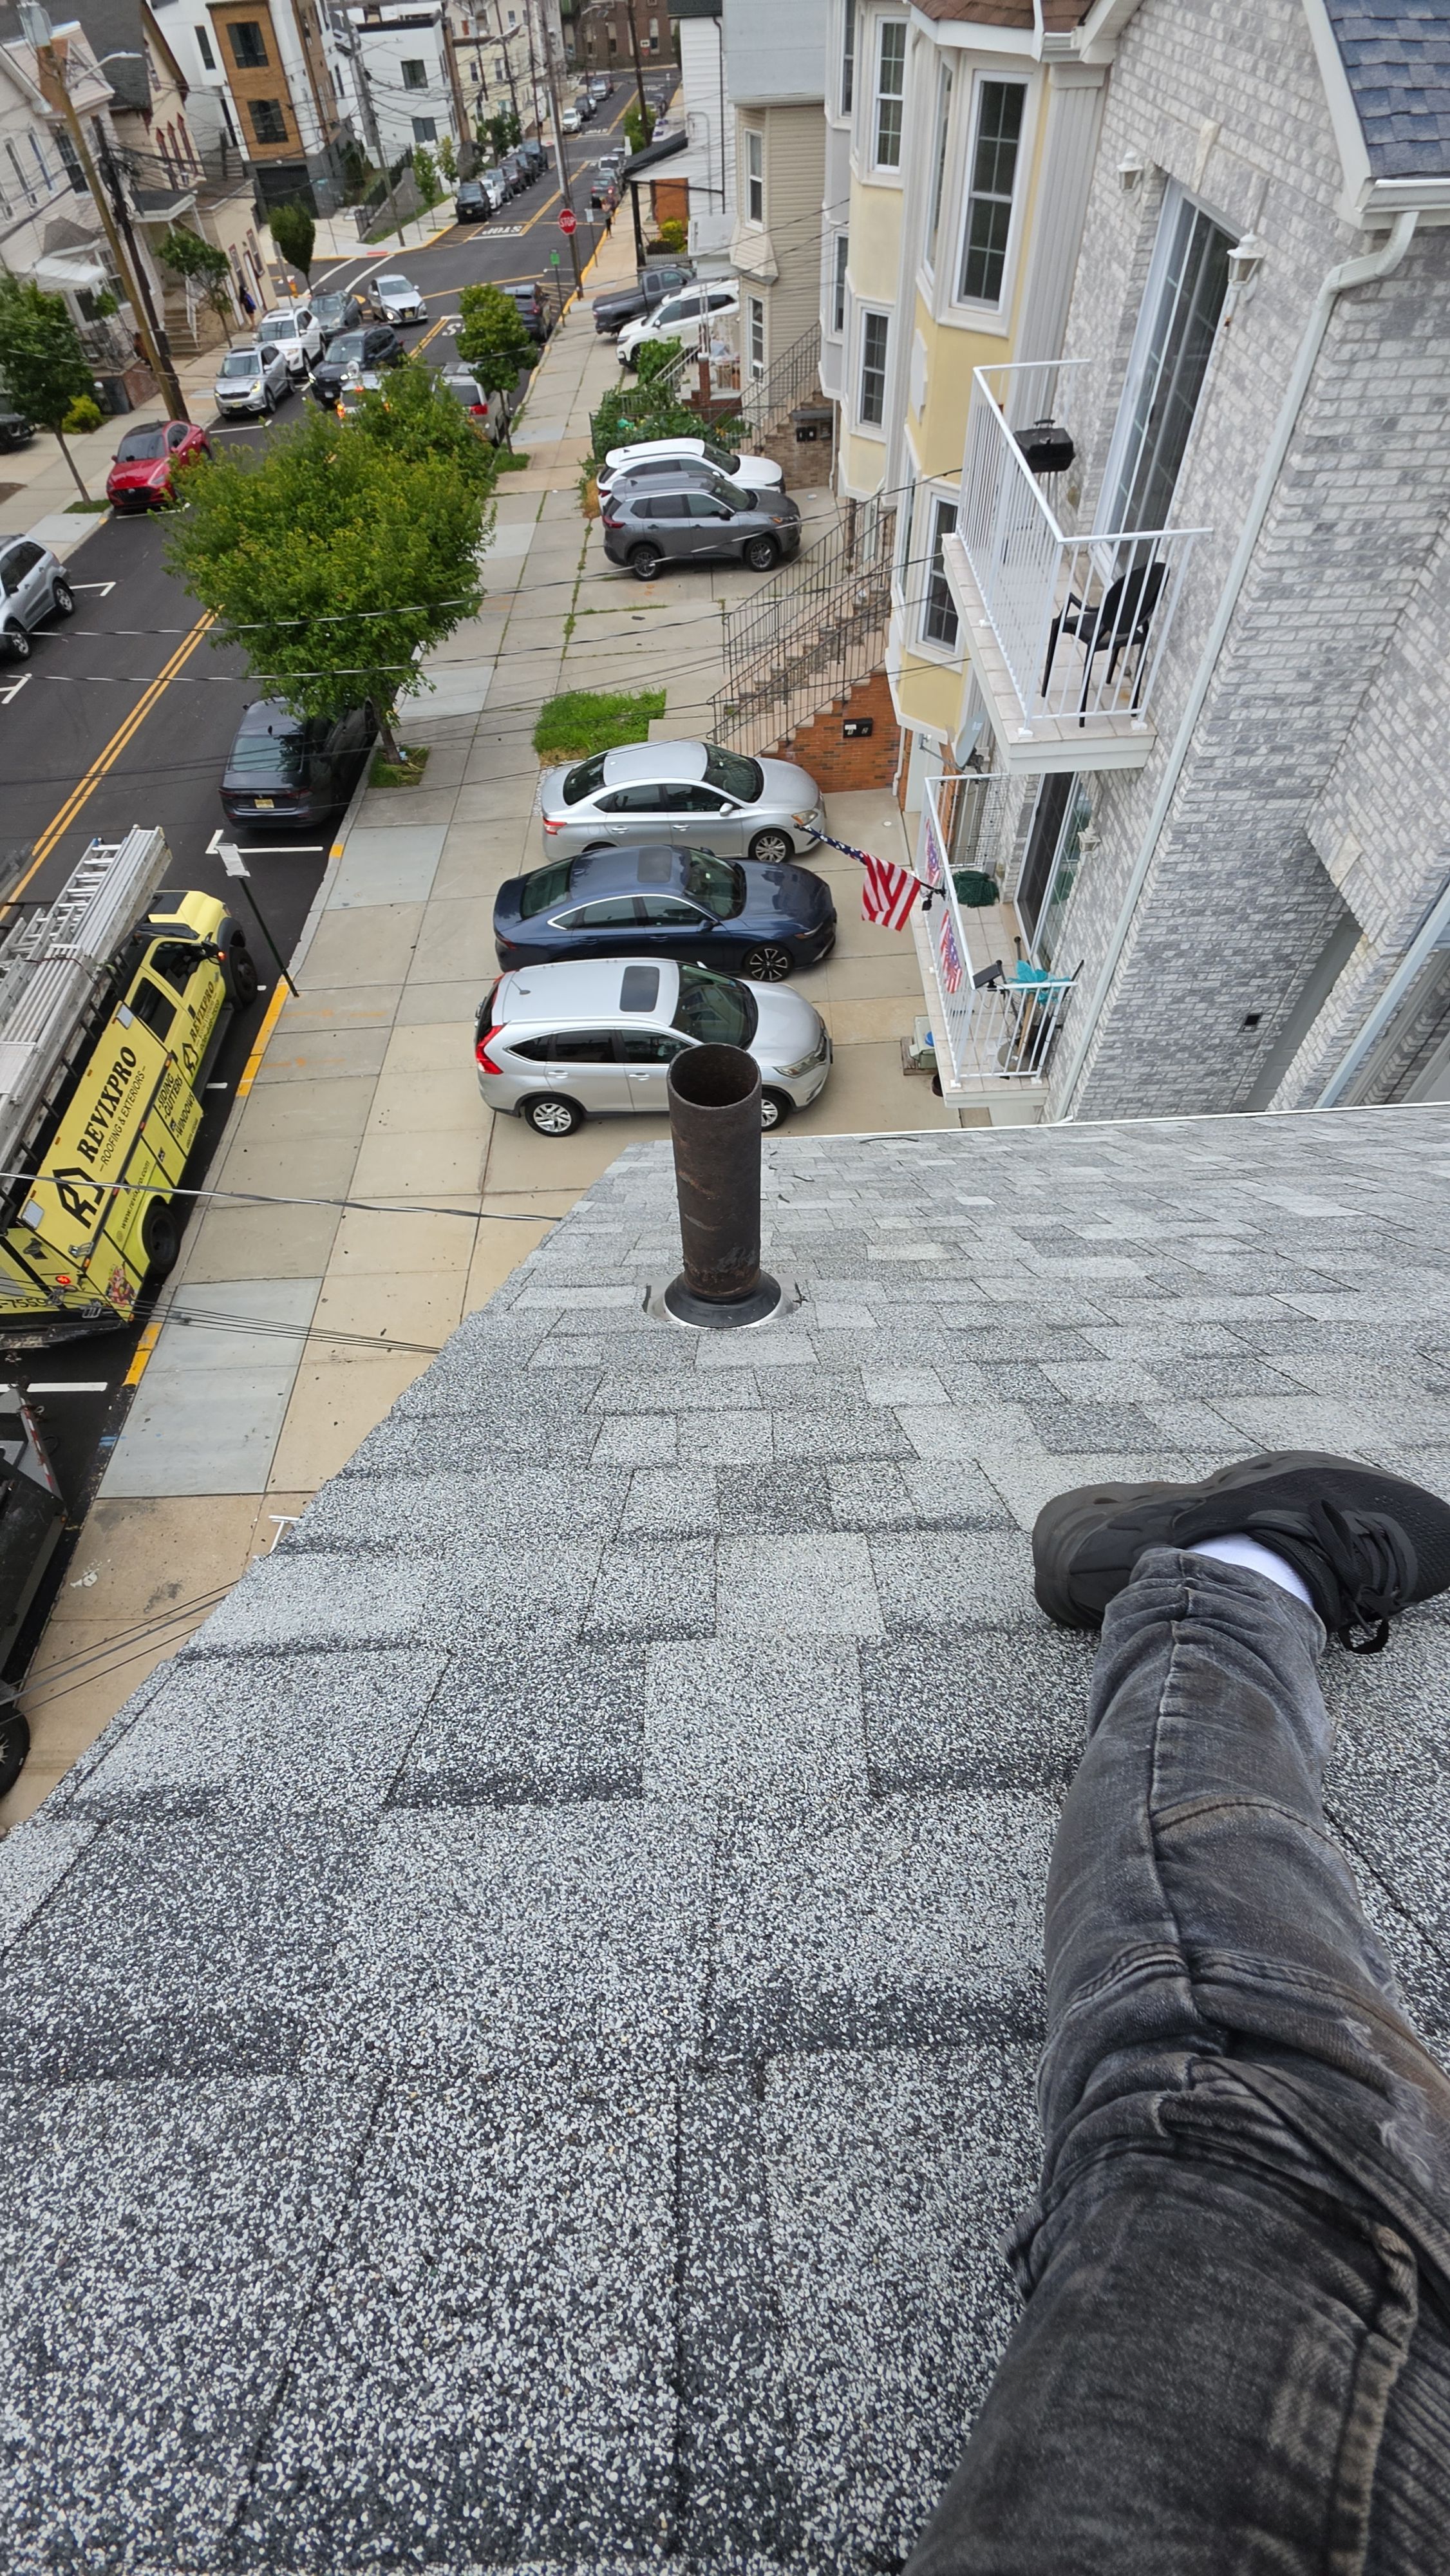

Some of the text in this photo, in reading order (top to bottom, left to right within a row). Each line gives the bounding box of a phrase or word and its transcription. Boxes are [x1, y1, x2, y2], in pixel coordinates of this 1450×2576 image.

[482, 225, 523, 235] STOP
[560, 216, 576, 227] STOP
[189, 981, 214, 1042] REVIXPRO
[77, 1046, 137, 1164] REVIXPRO
[101, 1070, 146, 1166] ROOFING & EXTERIORS
[121, 1160, 150, 1229] www.revixro.com
